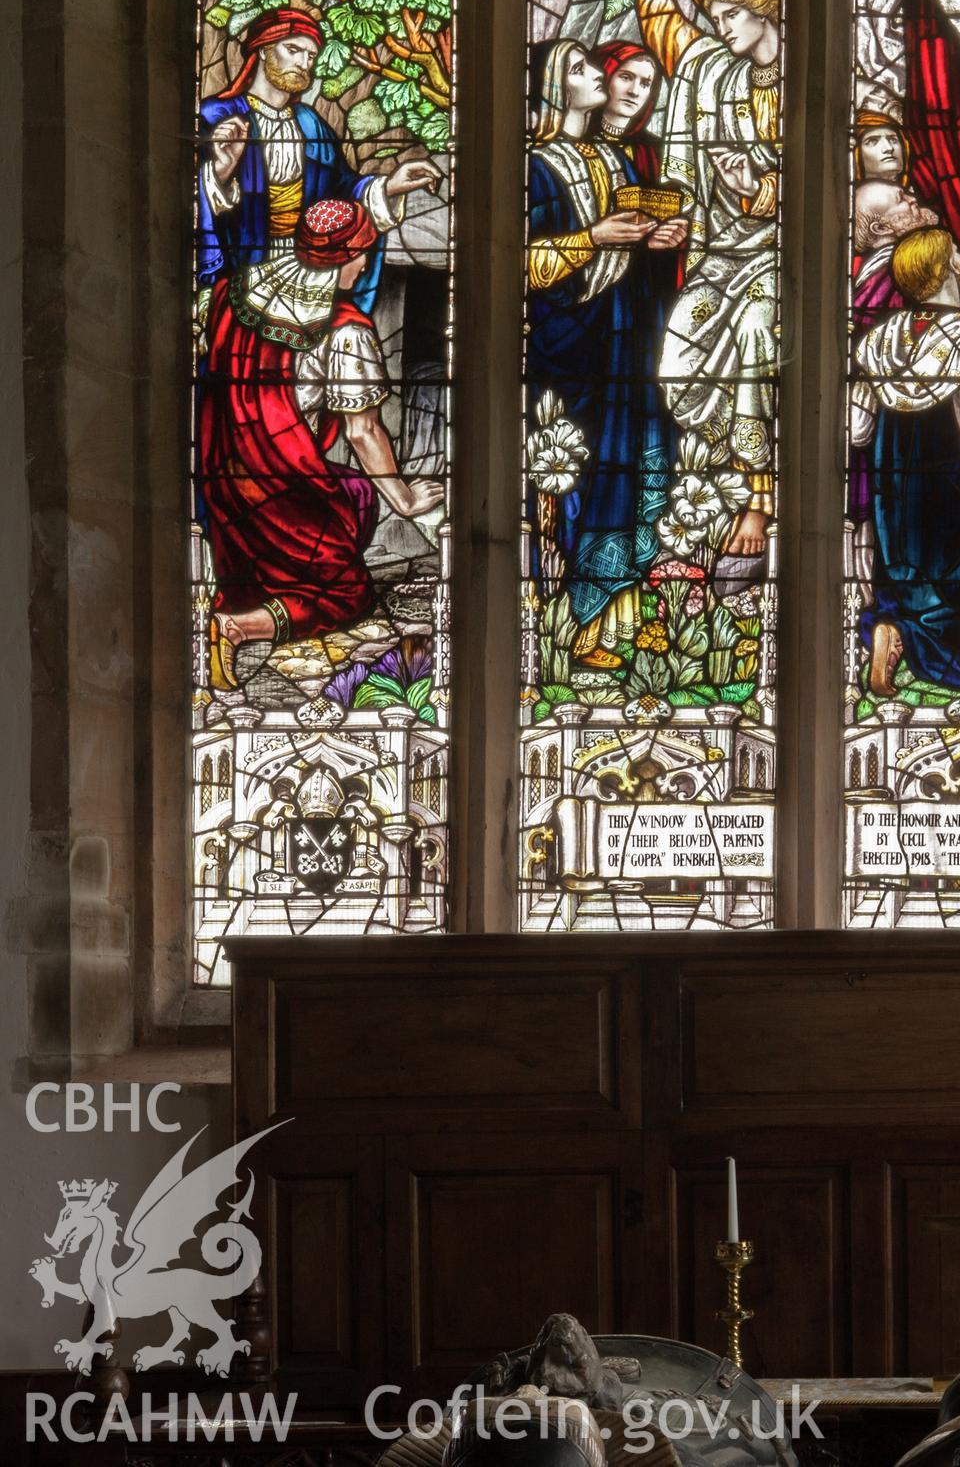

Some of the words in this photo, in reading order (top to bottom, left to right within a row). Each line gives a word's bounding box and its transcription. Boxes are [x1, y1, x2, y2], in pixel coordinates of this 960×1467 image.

[608, 815, 629, 829] THIS
[638, 815, 687, 829] WINDOW
[695, 815, 704, 828] IS
[712, 815, 764, 829] DEDICATED
[862, 813, 875, 827] TO
[879, 813, 896, 827] THE
[901, 813, 941, 827] HONOUR
[608, 834, 620, 848] OF
[631, 834, 659, 848] THEIR
[669, 834, 712, 848] BELOVED
[723, 834, 764, 848] PARENTS
[877, 833, 890, 847] BY
[902, 833, 927, 847] CECIL
[369, 859, 379, 869] OF
[608, 853, 620, 868] OF
[673, 853, 715, 867] DENBIGH
[862, 852, 903, 866] ERECTED
[270, 883, 283, 891] SEE
[349, 881, 376, 889] ASAPH
